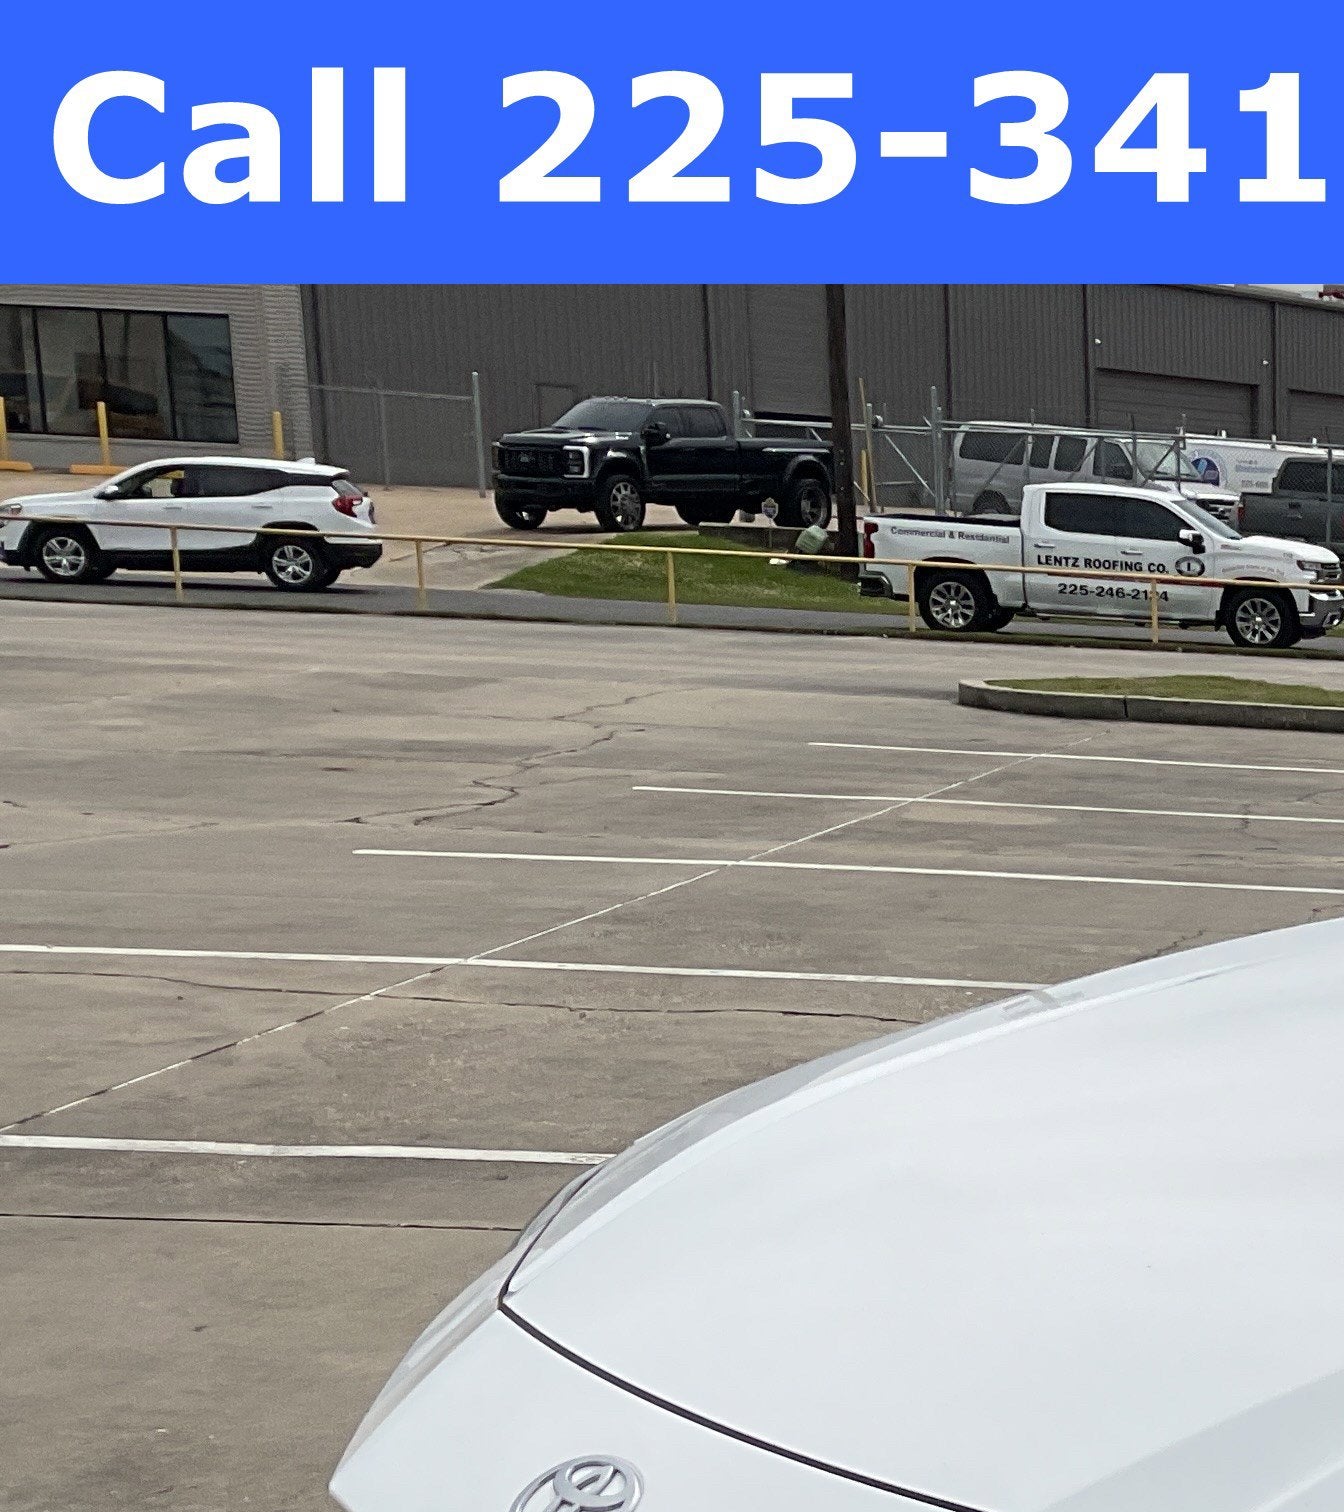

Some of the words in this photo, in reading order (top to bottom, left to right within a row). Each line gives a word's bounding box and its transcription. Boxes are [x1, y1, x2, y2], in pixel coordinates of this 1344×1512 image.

[890, 526, 946, 539] Commercial
[958, 531, 1010, 545] Residential
[1037, 554, 1080, 569] LENTZ
[1084, 557, 1143, 573] ROOFING
[1148, 562, 1170, 575] CO.
